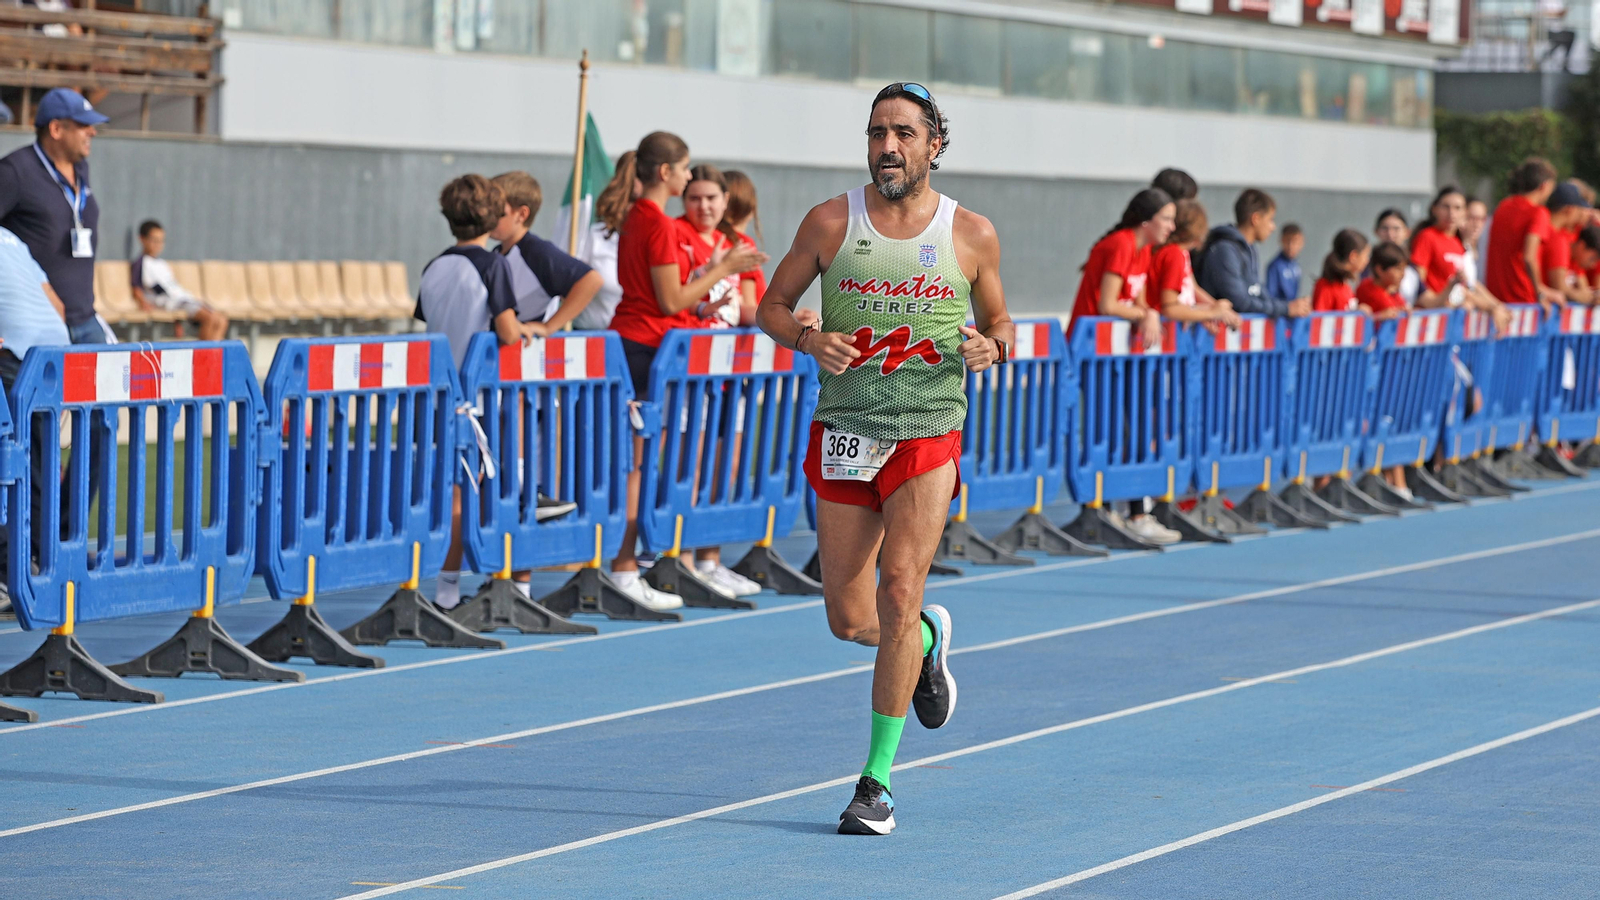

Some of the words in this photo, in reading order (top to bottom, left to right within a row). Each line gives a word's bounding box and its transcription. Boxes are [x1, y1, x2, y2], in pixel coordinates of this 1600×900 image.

[839, 274, 955, 300] maratón
[857, 299, 934, 314] JEREZ
[827, 434, 860, 459] 368
